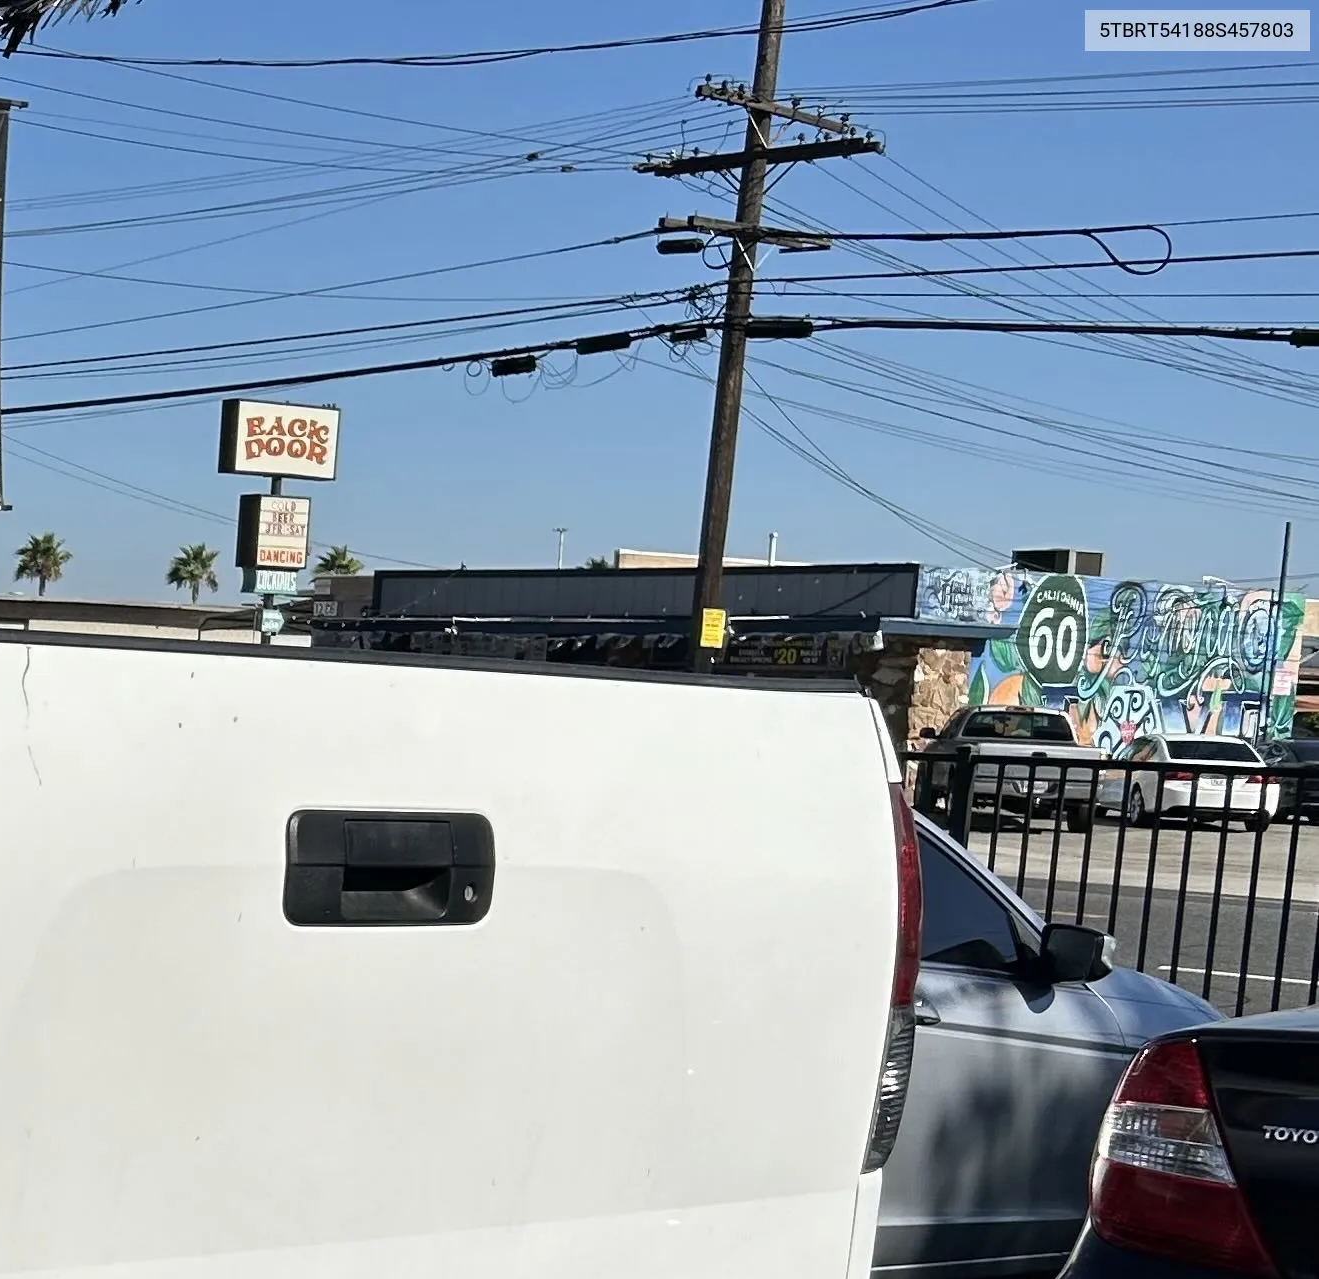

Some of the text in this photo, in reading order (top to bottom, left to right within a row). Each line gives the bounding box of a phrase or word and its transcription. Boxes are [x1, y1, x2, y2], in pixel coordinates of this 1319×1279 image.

[246, 416, 329, 444] BACK
[245, 437, 327, 465] DOOR
[272, 512, 295, 523] BEER
[259, 550, 303, 564] DANCING
[1029, 607, 1078, 672] 60
[1262, 1125, 1319, 1144] TOYO
